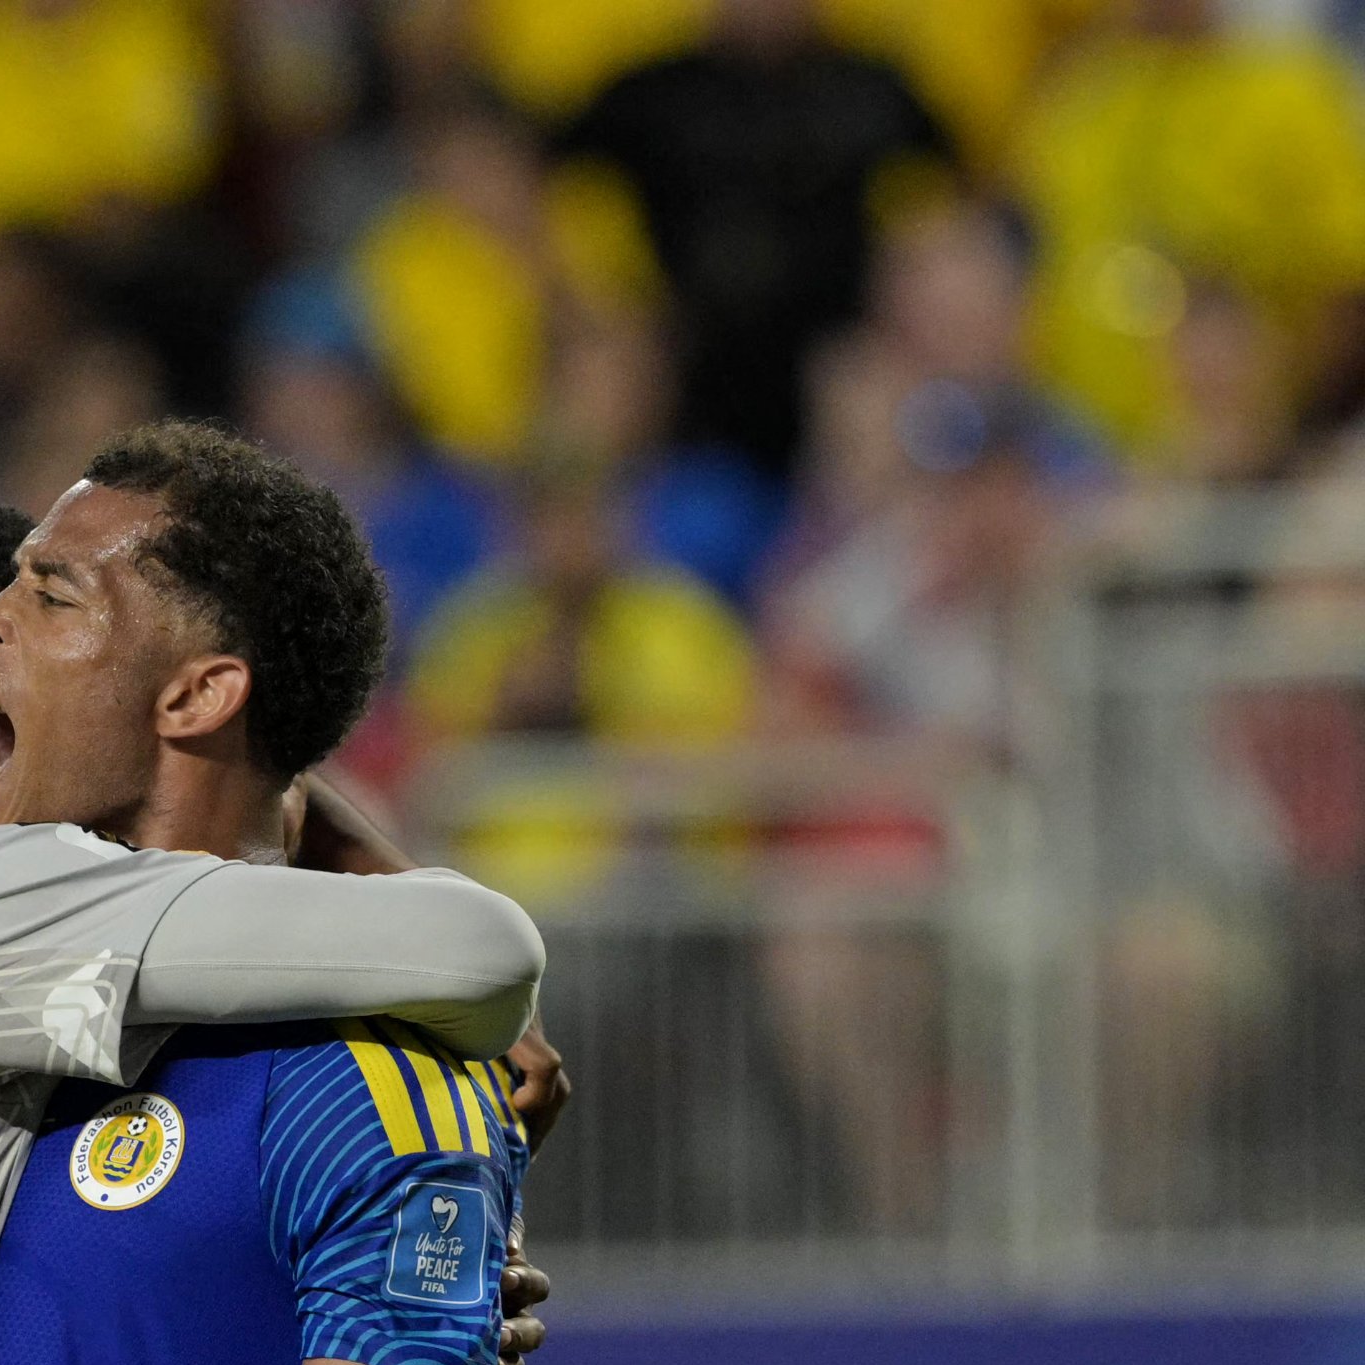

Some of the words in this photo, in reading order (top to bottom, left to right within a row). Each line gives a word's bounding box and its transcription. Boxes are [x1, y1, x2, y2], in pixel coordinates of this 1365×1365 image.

[76, 1101, 133, 1184] Federashon
[415, 1232, 447, 1256] Unite
[448, 1237, 465, 1258] For
[415, 1255, 460, 1281] PEACE
[421, 1281, 446, 1294] FIFA
